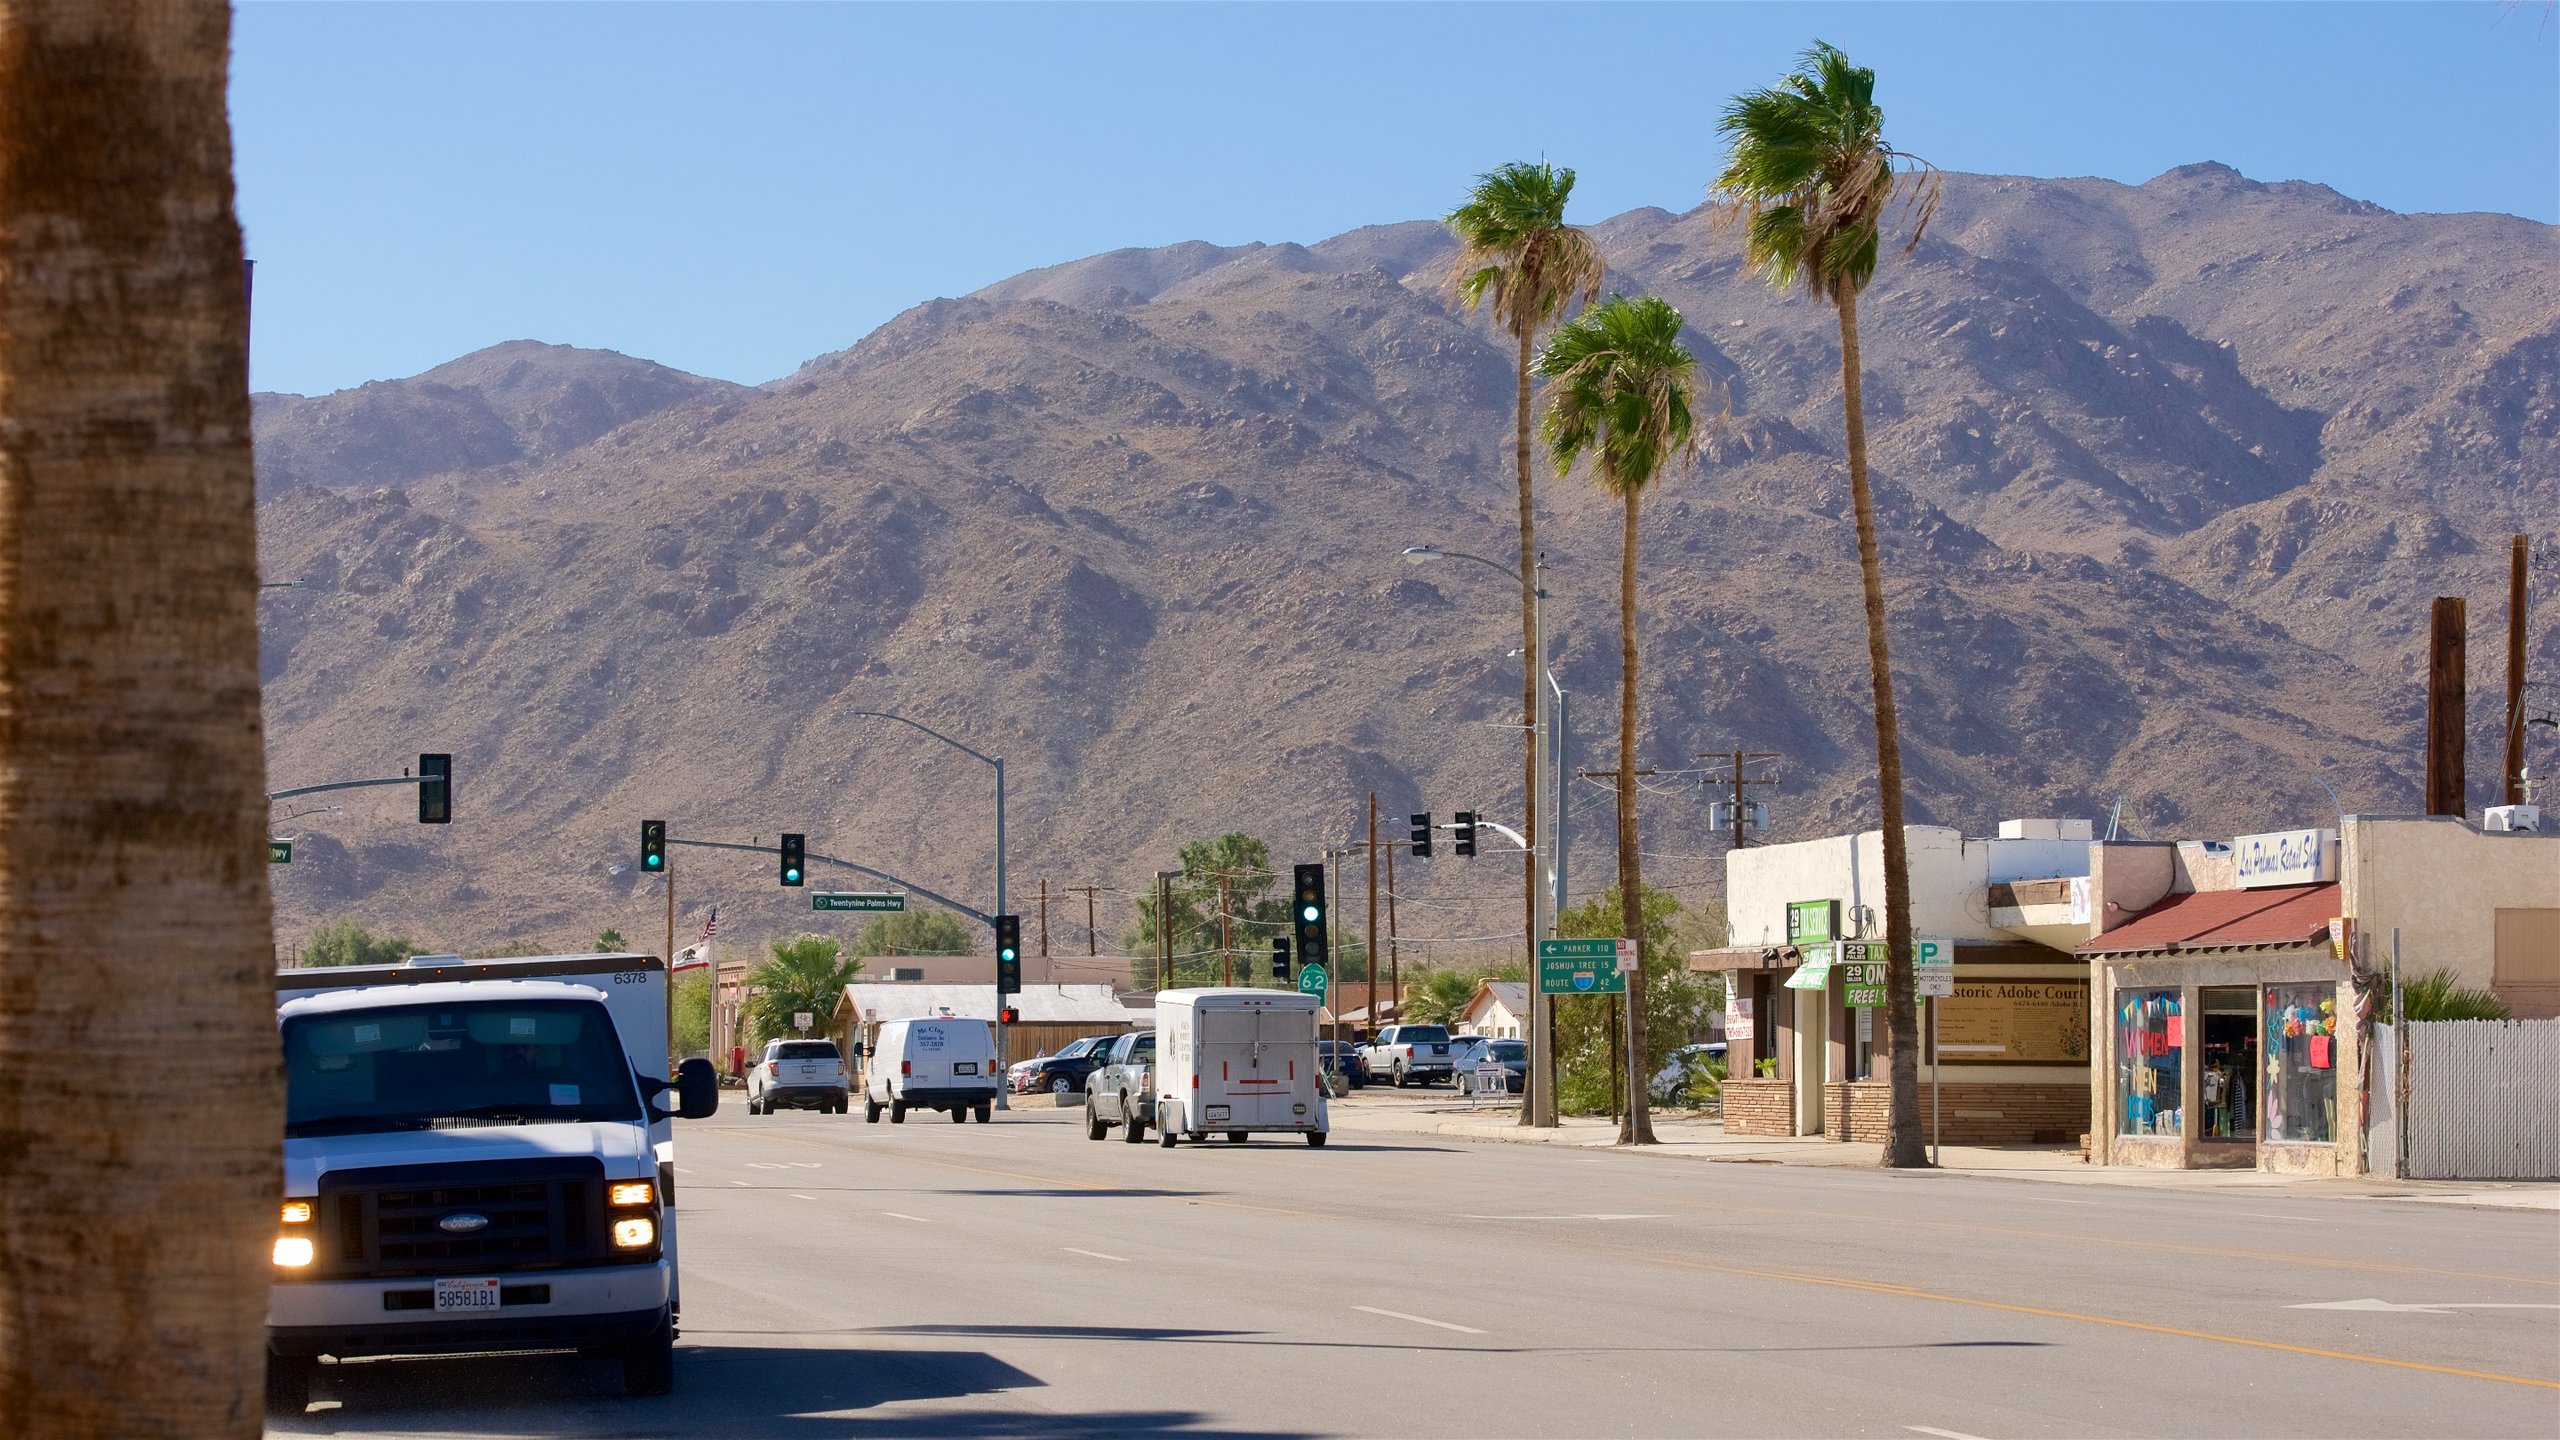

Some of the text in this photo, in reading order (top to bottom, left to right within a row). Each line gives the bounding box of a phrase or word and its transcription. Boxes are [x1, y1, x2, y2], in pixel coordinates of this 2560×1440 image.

[2239, 844, 2252, 877] Las
[2253, 841, 2278, 877] Palmas
[2280, 838, 2302, 873] Retail
[830, 899, 902, 908] Twentynine Palms Hwy
[1791, 908, 1799, 927] 29
[1563, 945, 1591, 953] PARKER
[1847, 945, 1865, 955] 29
[1870, 945, 1885, 960] TAX
[1546, 962, 1575, 970] JOSHUA
[1846, 966, 1862, 977] 29
[614, 972, 647, 984] 6378
[1303, 975, 1324, 989] 62
[1545, 979, 1569, 987] ROUTE
[1848, 988, 1878, 1003] FREE!
[1997, 985, 2040, 999] Adobe
[2045, 986, 2084, 999] Court
[2125, 1027, 2169, 1058] WOMEN
[2132, 1064, 2157, 1095] MEN
[2128, 1095, 2155, 1126] KIDS
[447, 1280, 484, 1290] California
[439, 1290, 496, 1307] 58581B1
